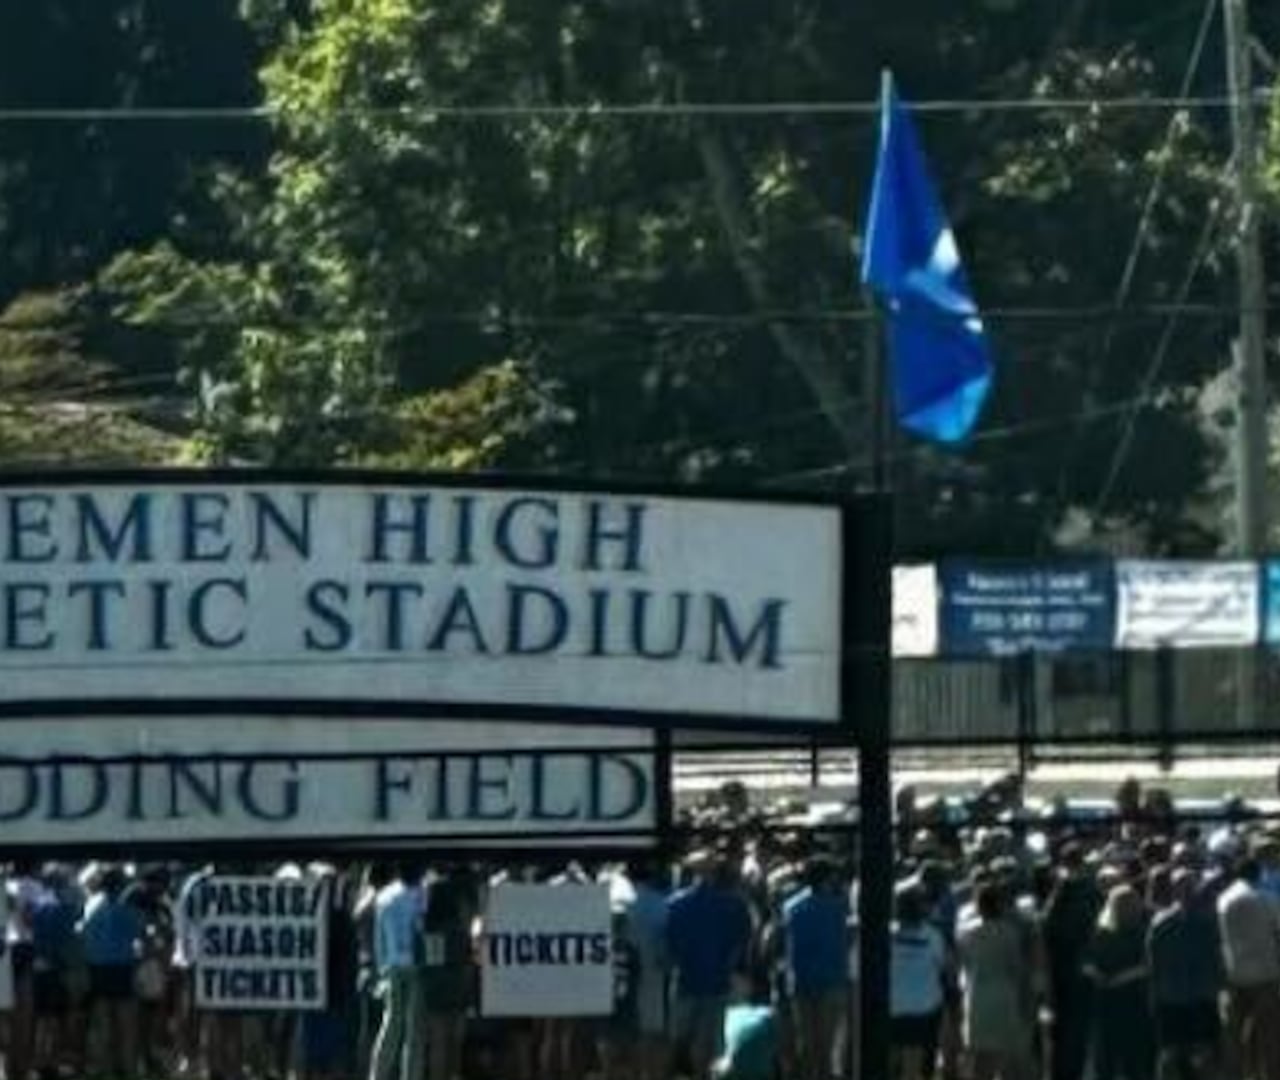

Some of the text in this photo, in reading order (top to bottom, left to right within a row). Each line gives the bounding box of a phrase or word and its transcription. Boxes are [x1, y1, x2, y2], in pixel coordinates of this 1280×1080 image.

[363, 491, 647, 572] HIGH
[303, 578, 792, 671] STADIUM
[370, 748, 649, 822] FIELD
[202, 923, 318, 959] SEASON
[487, 931, 609, 966] TICKETS
[201, 966, 319, 1000] TICKETS
